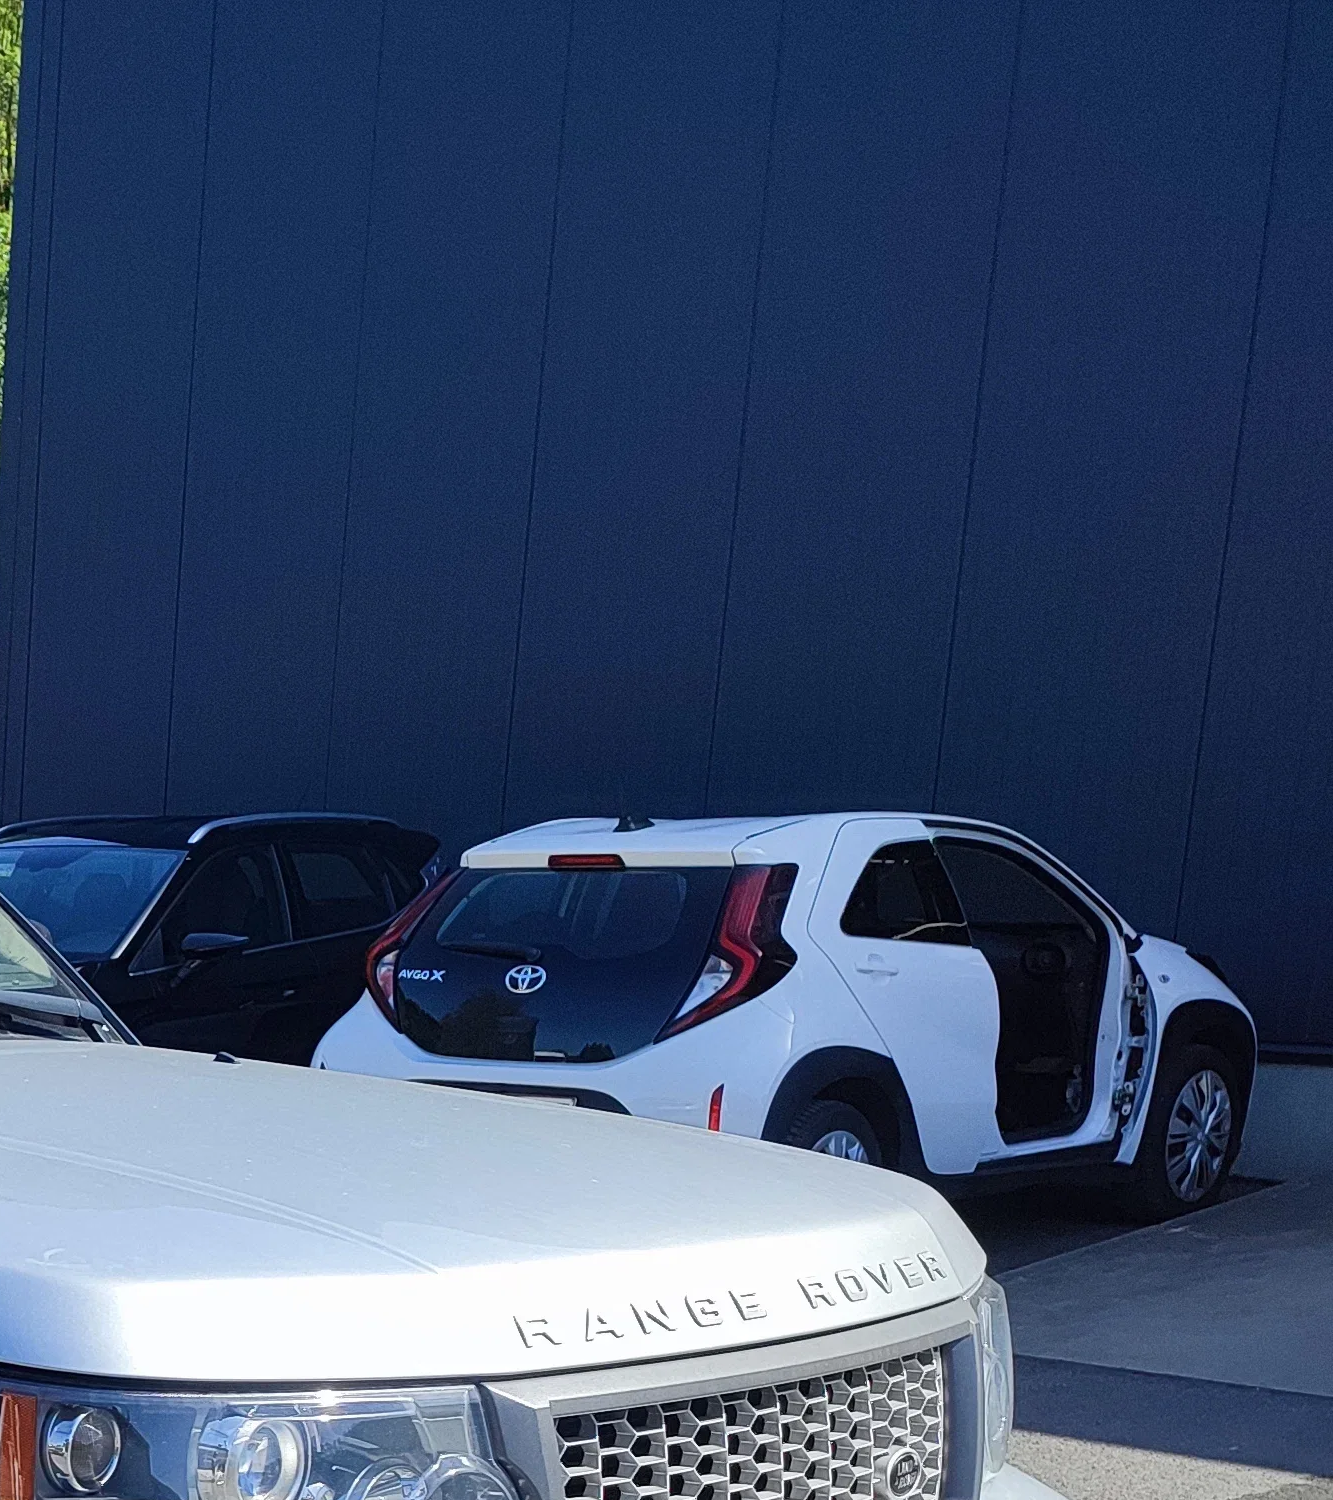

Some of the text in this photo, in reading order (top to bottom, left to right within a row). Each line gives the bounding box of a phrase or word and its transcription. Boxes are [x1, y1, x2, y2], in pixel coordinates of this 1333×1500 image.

[429, 969, 446, 983] X
[512, 1250, 948, 1348] RANGE ROVER
